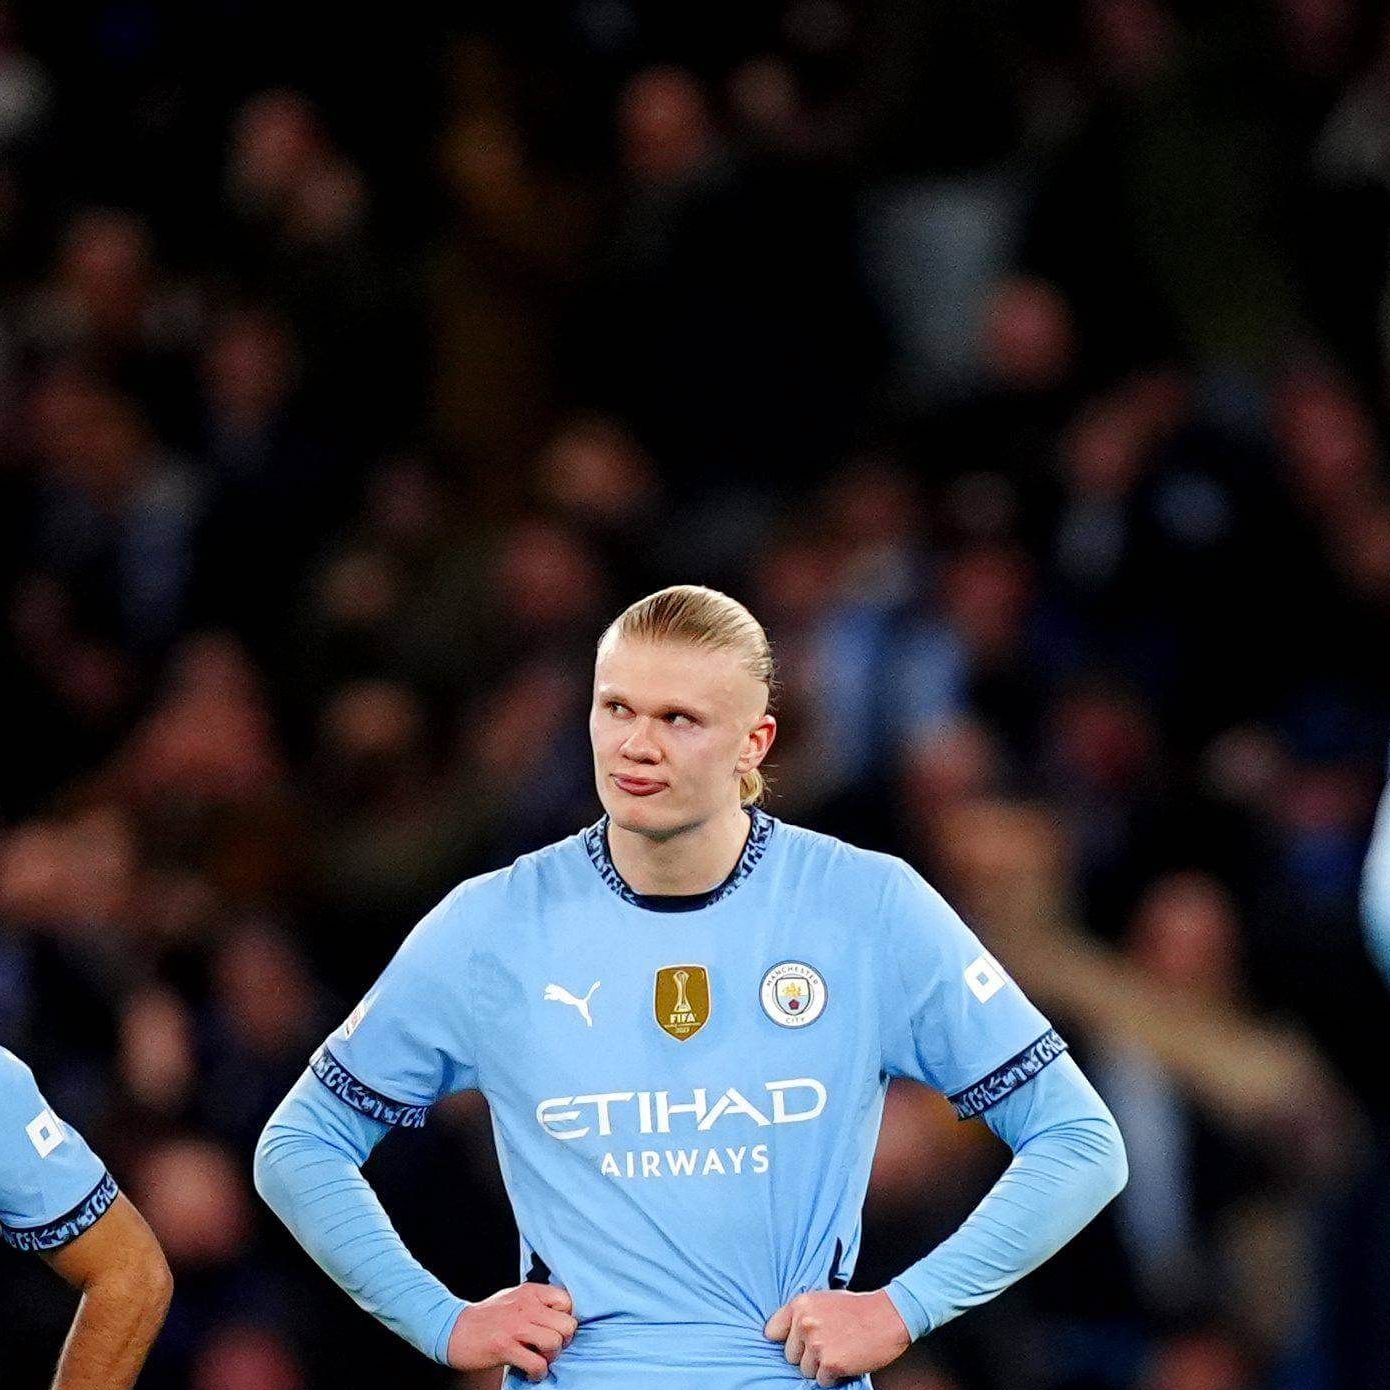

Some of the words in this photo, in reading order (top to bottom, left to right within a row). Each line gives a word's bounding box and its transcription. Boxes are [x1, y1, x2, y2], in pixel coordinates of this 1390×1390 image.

[670, 1012, 696, 1023] FIFA
[536, 1078, 828, 1141] ETIHAD
[600, 1144, 770, 1178] AIRWAYS
